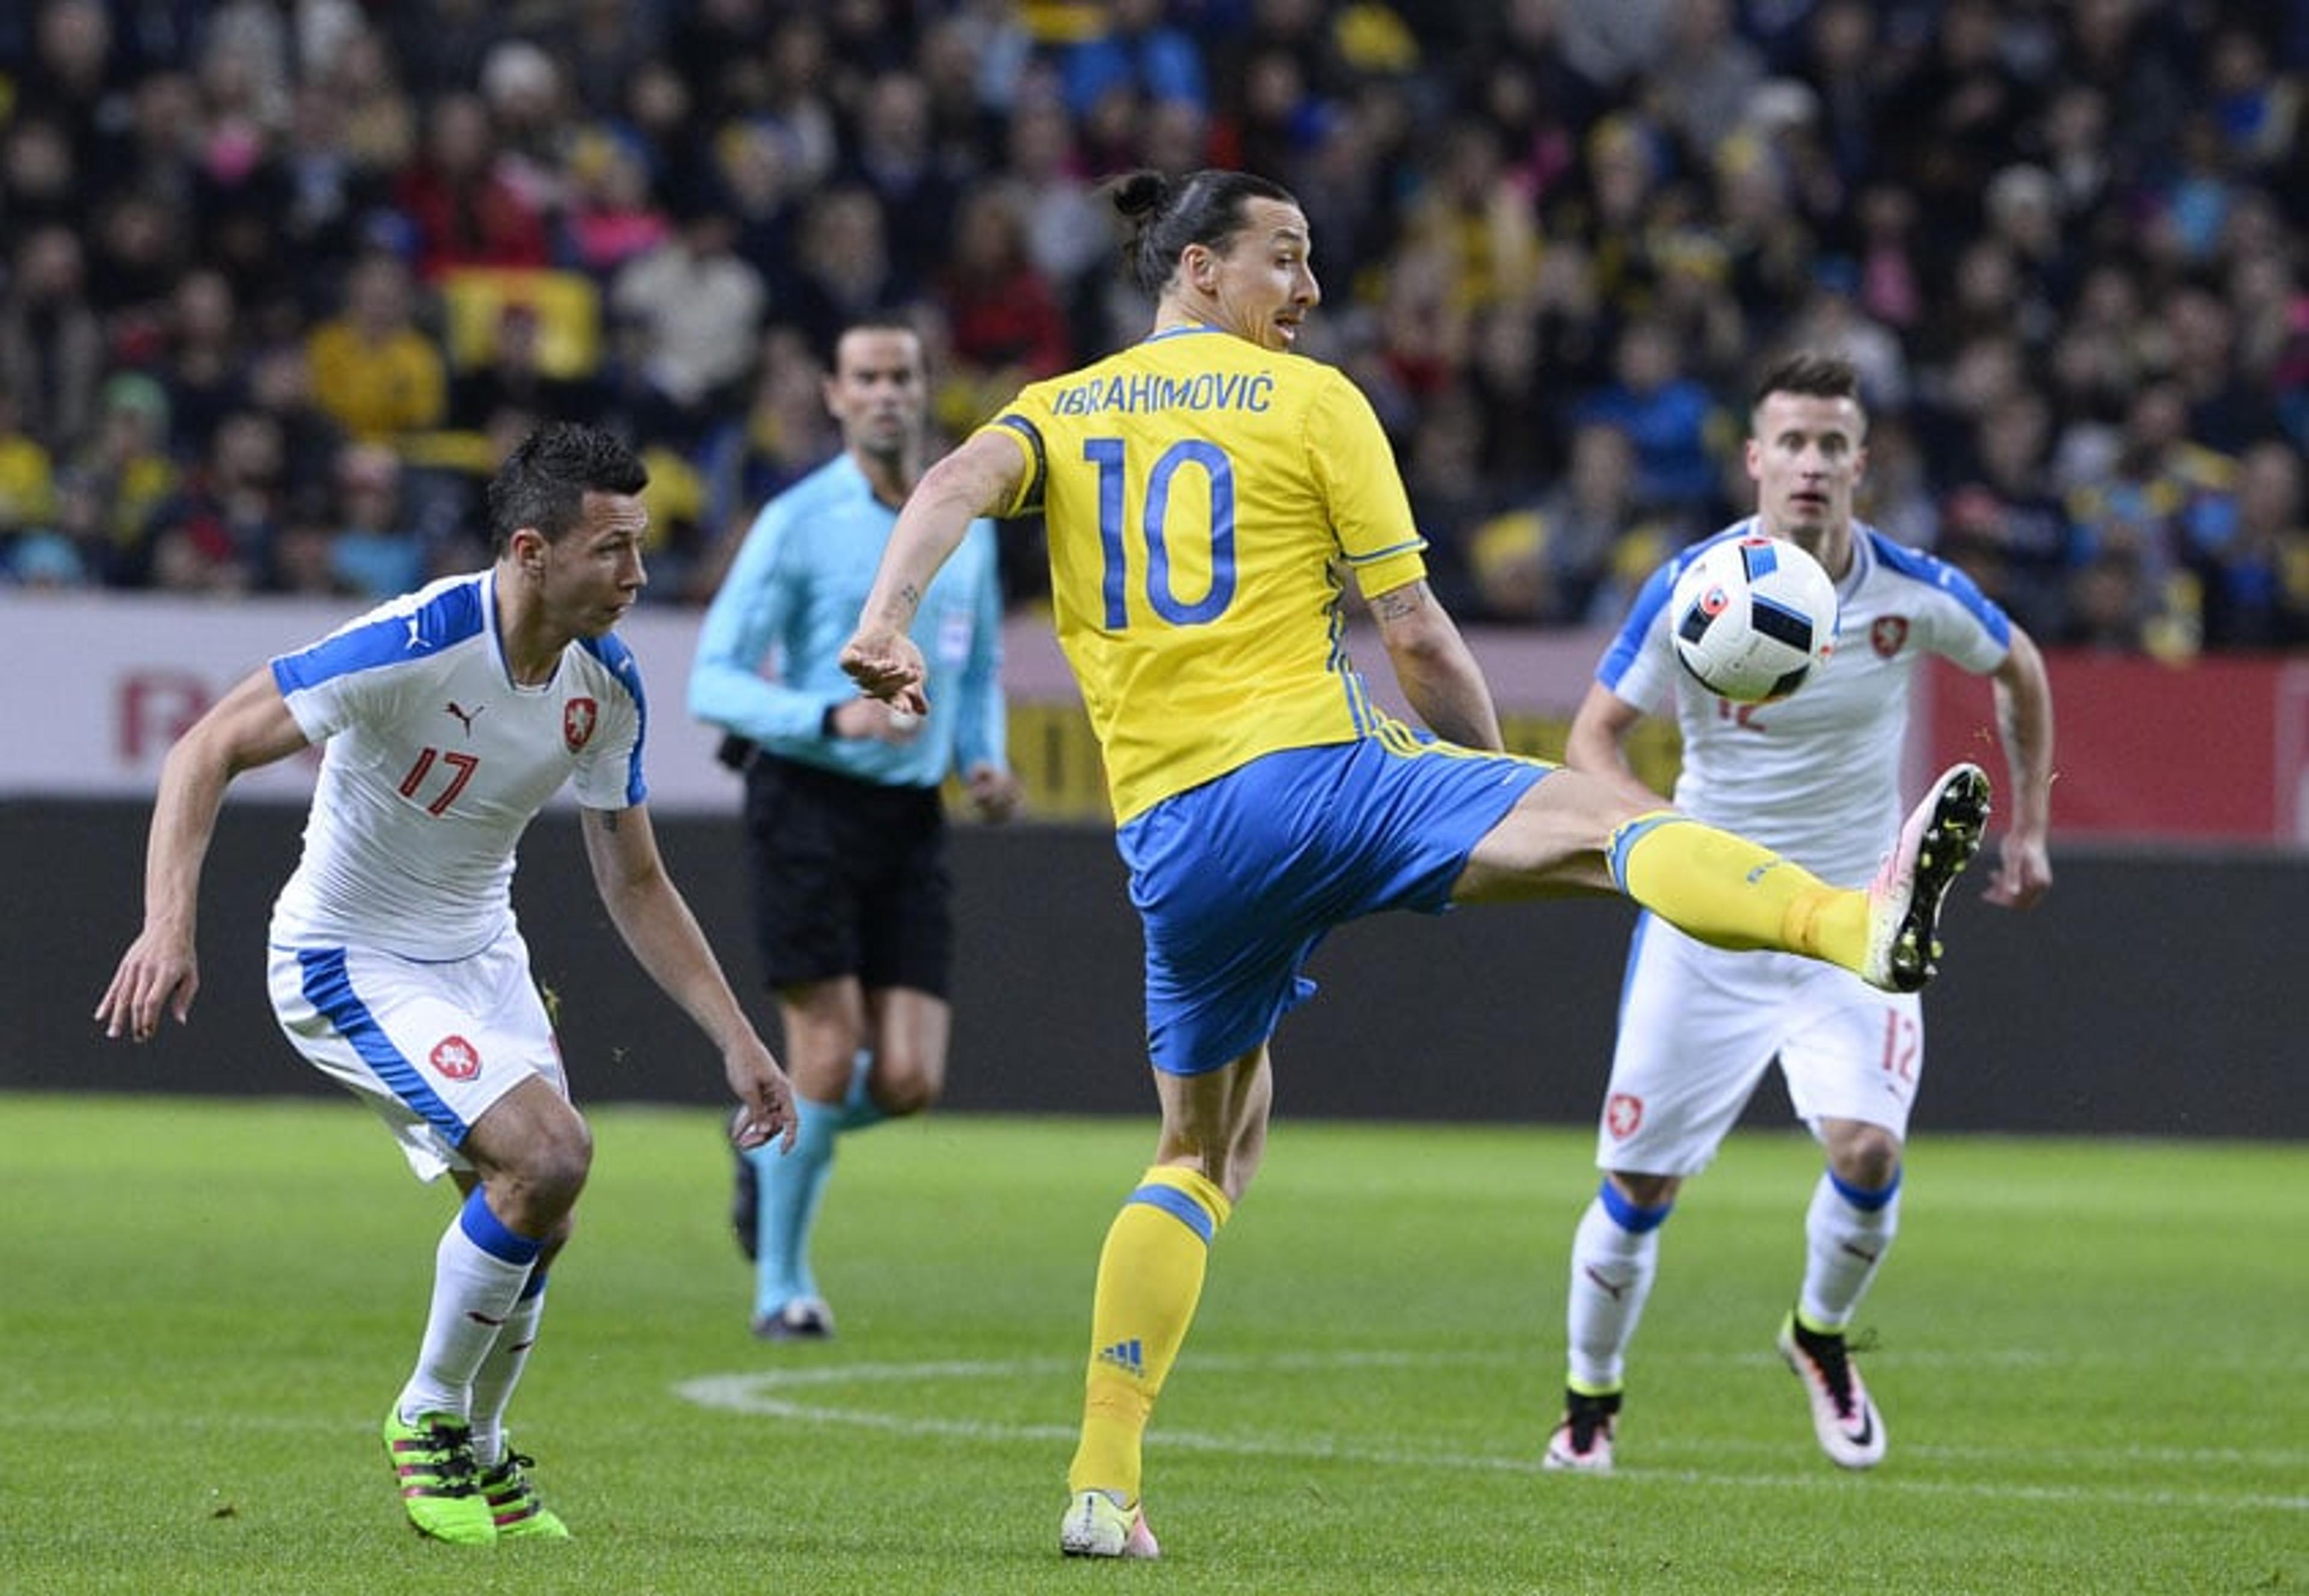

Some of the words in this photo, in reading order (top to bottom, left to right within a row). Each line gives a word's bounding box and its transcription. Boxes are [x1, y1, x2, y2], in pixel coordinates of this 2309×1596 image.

[1053, 370, 1272, 415] IBRAHIMOVIĆ
[1084, 438, 1237, 631] 10
[399, 747, 479, 816] 17
[1883, 1007, 1917, 1084] 12
